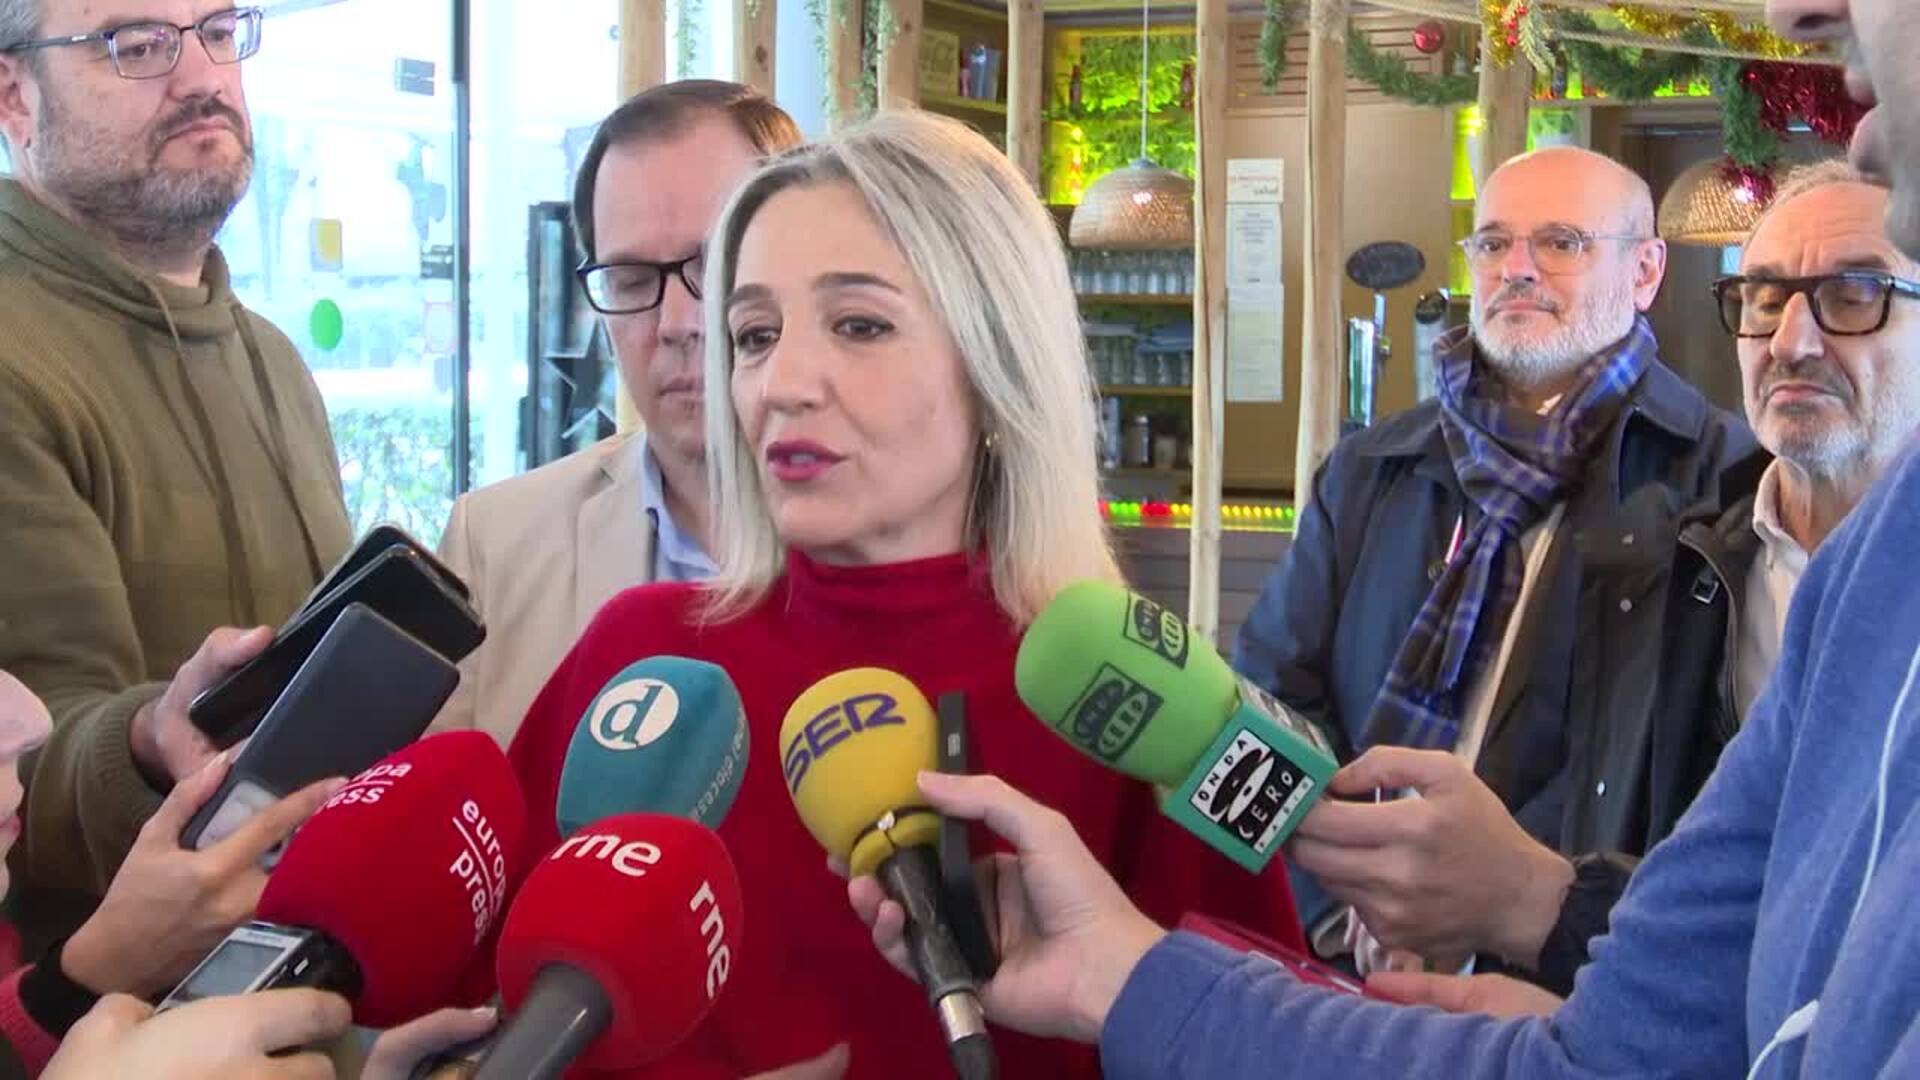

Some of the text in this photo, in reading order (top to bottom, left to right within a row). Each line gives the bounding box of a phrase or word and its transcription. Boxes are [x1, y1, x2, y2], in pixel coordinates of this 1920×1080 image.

[600, 685, 664, 747] d
[785, 693, 907, 795] SER
[1198, 738, 1248, 802] ONDA
[1238, 772, 1294, 839] CERO
[551, 834, 662, 877] rne
[689, 880, 730, 999] rne
